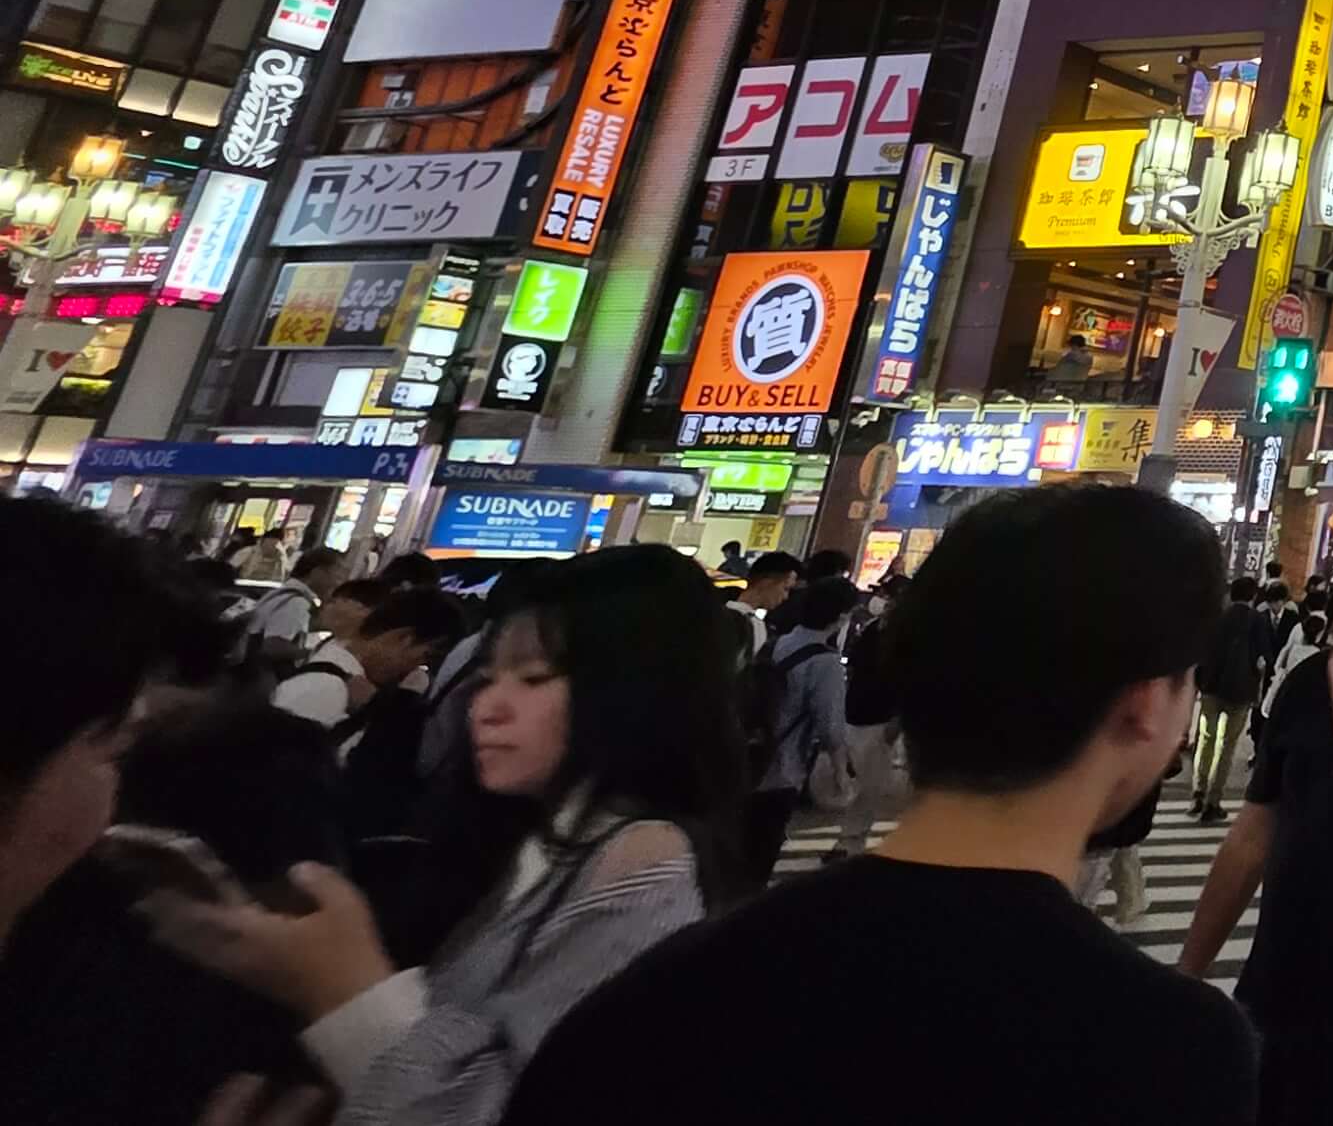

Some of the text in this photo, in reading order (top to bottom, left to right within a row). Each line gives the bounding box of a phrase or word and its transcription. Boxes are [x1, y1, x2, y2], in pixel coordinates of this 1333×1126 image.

[721, 73, 921, 145] アコム
[565, 107, 602, 184] RESALE
[592, 113, 625, 190] LUXURY
[351, 159, 505, 193] メンズライフ
[724, 155, 755, 178] 3F
[341, 200, 463, 236] クリニック
[746, 287, 813, 368] 質
[697, 384, 749, 407] BUY
[763, 384, 820, 407] SELL
[88, 448, 179, 469] SUBNADE
[443, 465, 537, 482] SUBNADE
[456, 495, 577, 519] SUBNADE
